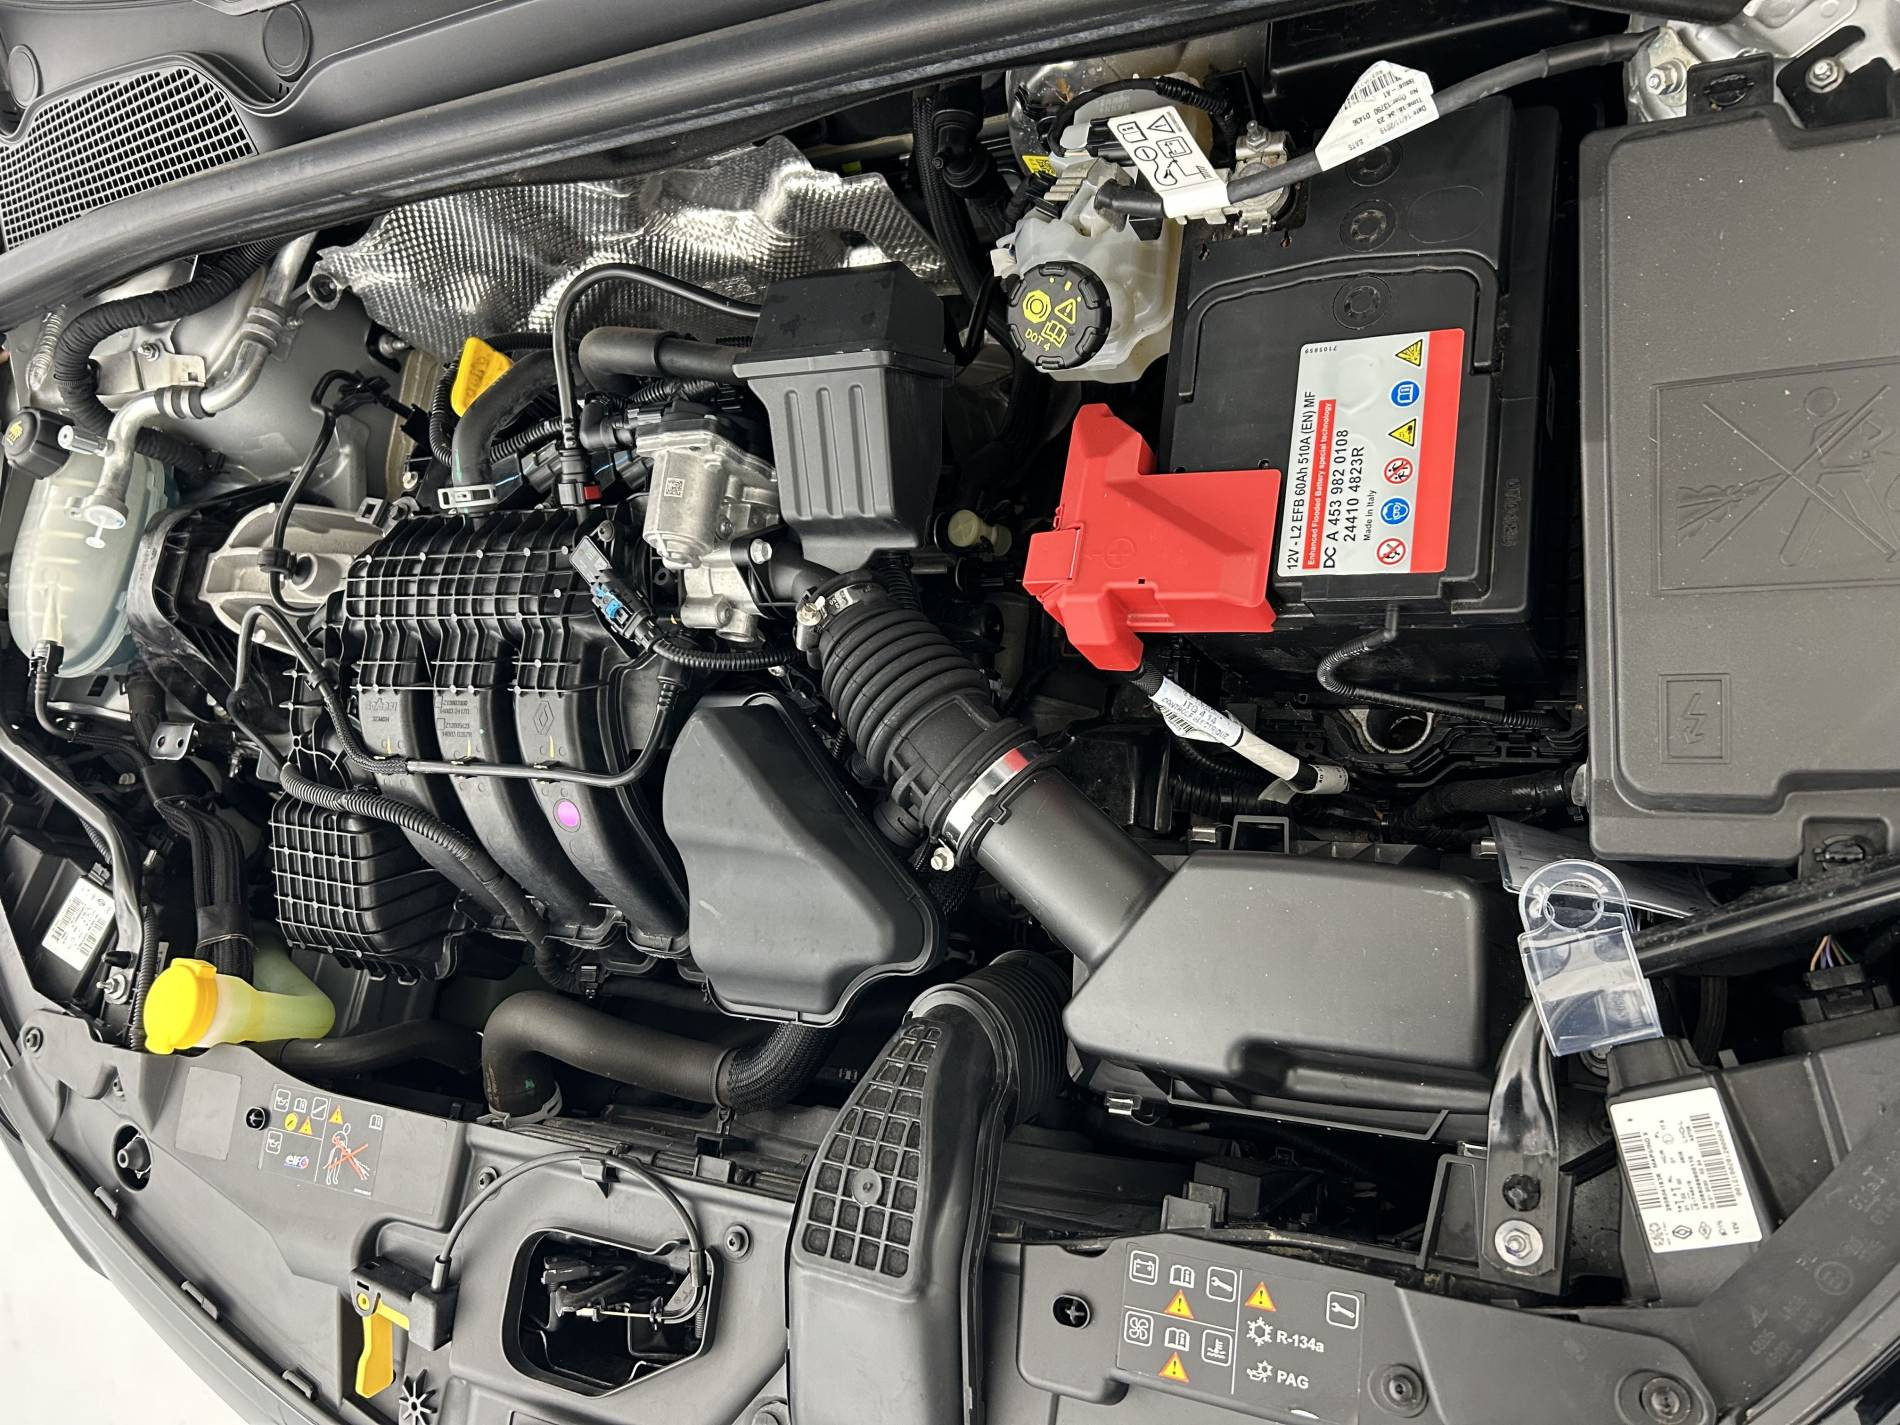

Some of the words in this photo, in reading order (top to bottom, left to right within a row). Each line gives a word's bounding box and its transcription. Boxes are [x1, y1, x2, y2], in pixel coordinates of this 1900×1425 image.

[1025, 329, 1044, 346] DOT
[1043, 342, 1050, 351] 4
[1304, 391, 1315, 407] MF
[1300, 409, 1316, 434] (EN)
[1319, 402, 1332, 442] technology
[1297, 435, 1311, 464] 510A
[1317, 443, 1328, 468] special
[1333, 428, 1348, 463] 0108
[1294, 466, 1307, 495] 60Ah
[1330, 467, 1344, 494] 982
[1347, 445, 1365, 492] 4823R
[1314, 469, 1326, 496] Battery
[1291, 498, 1304, 522] EFB
[1366, 489, 1376, 507] Italy
[1311, 497, 1321, 526] Flooded
[1327, 499, 1341, 525] 453
[1342, 497, 1360, 542] 24410
[1365, 508, 1373, 516] in
[1290, 524, 1301, 539] L2
[1327, 530, 1338, 540] A
[1363, 518, 1373, 540] Made
[1308, 527, 1319, 564] Enhanced
[1287, 549, 1299, 570] 12V
[285, 1154, 303, 1167] elf
[1276, 1330, 1325, 1353] R-134a
[1276, 1369, 1309, 1391] PAG
